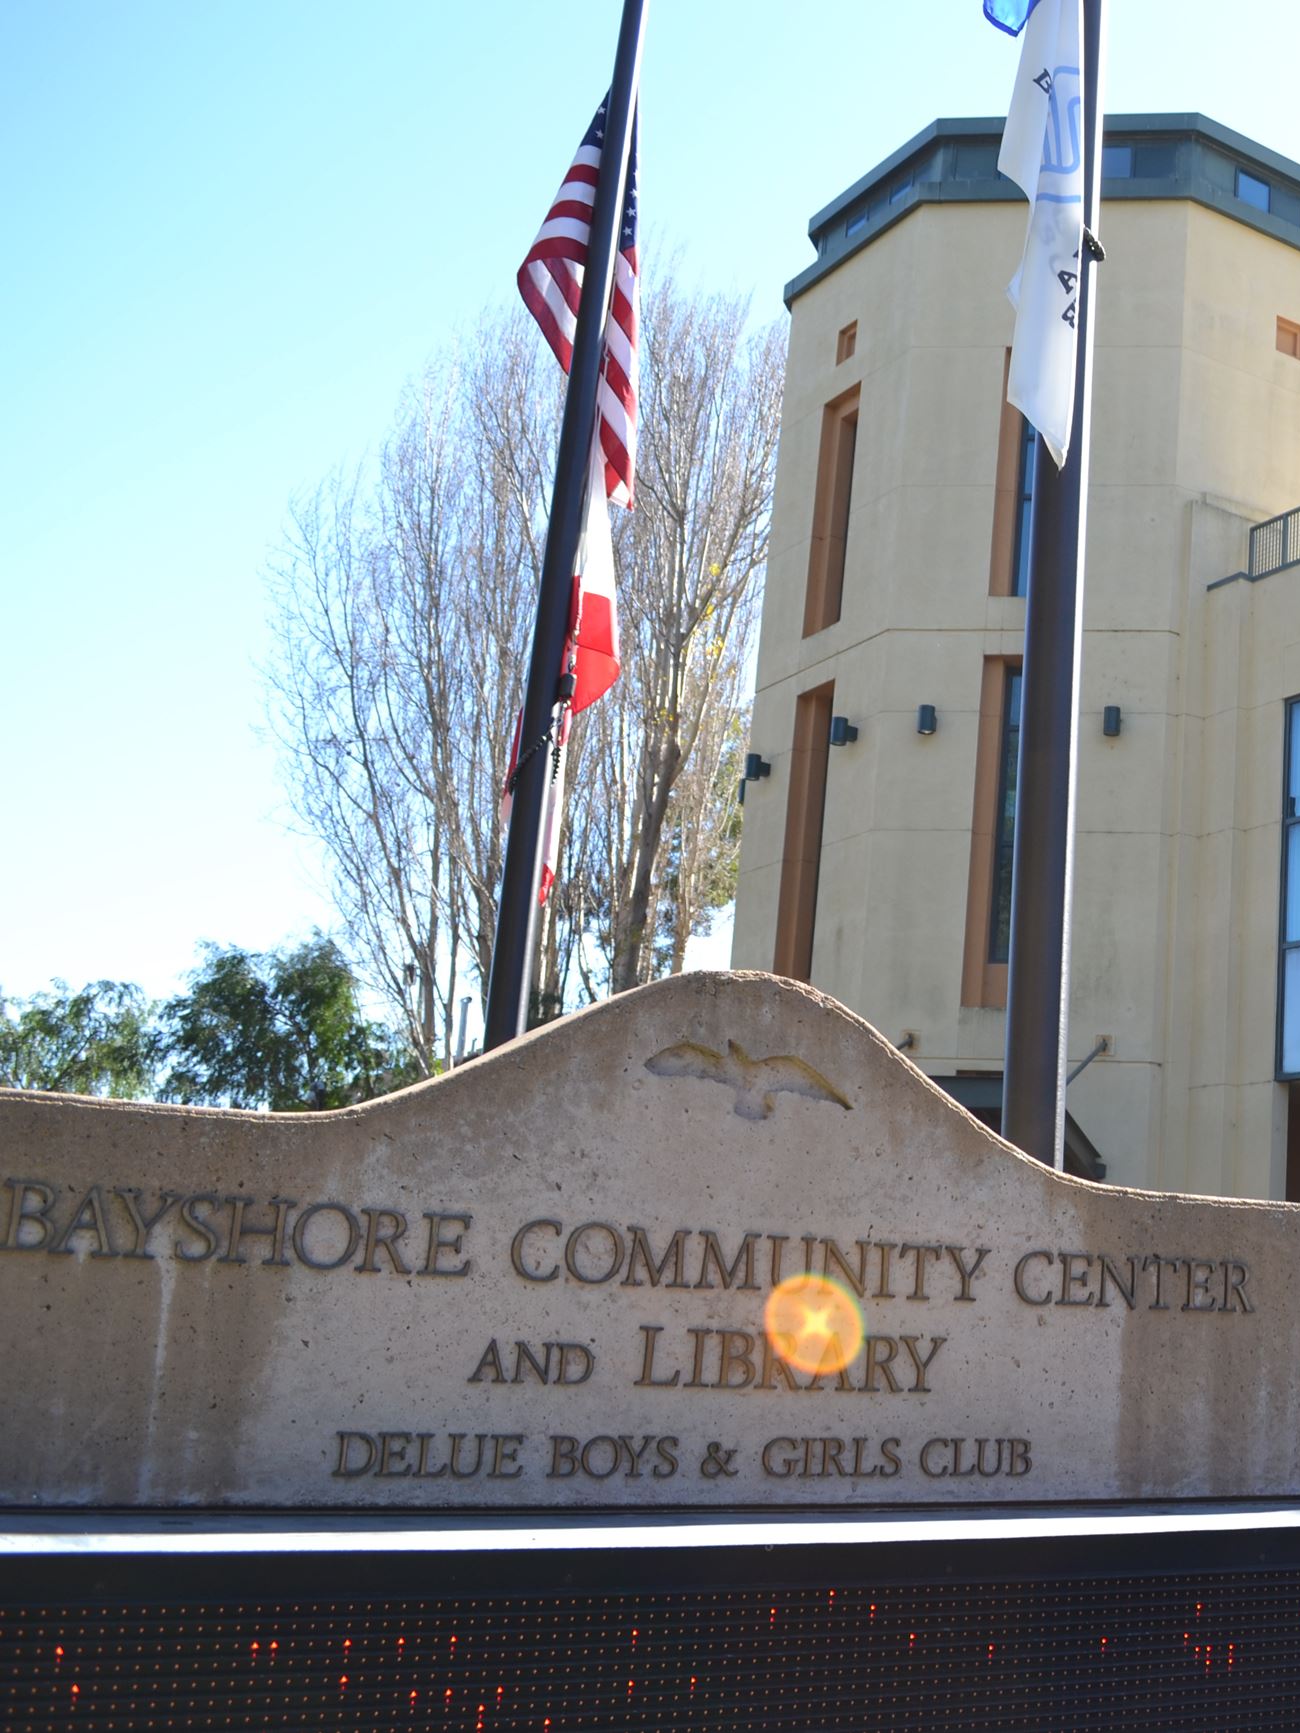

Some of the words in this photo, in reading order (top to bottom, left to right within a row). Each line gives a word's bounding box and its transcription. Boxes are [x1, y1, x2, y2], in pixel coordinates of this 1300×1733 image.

[1, 1178, 472, 1278] BAYSHORE
[510, 1218, 992, 1303] COMMUNITY
[1012, 1249, 1255, 1313] CENTER
[467, 1338, 596, 1385] AND
[633, 1325, 947, 1393] LIBRARY
[332, 1430, 523, 1478] DELUE
[547, 1434, 680, 1478] BOYS
[699, 1441, 738, 1478] &
[761, 1437, 901, 1479] GIRLS
[918, 1437, 1033, 1478] CLUB
